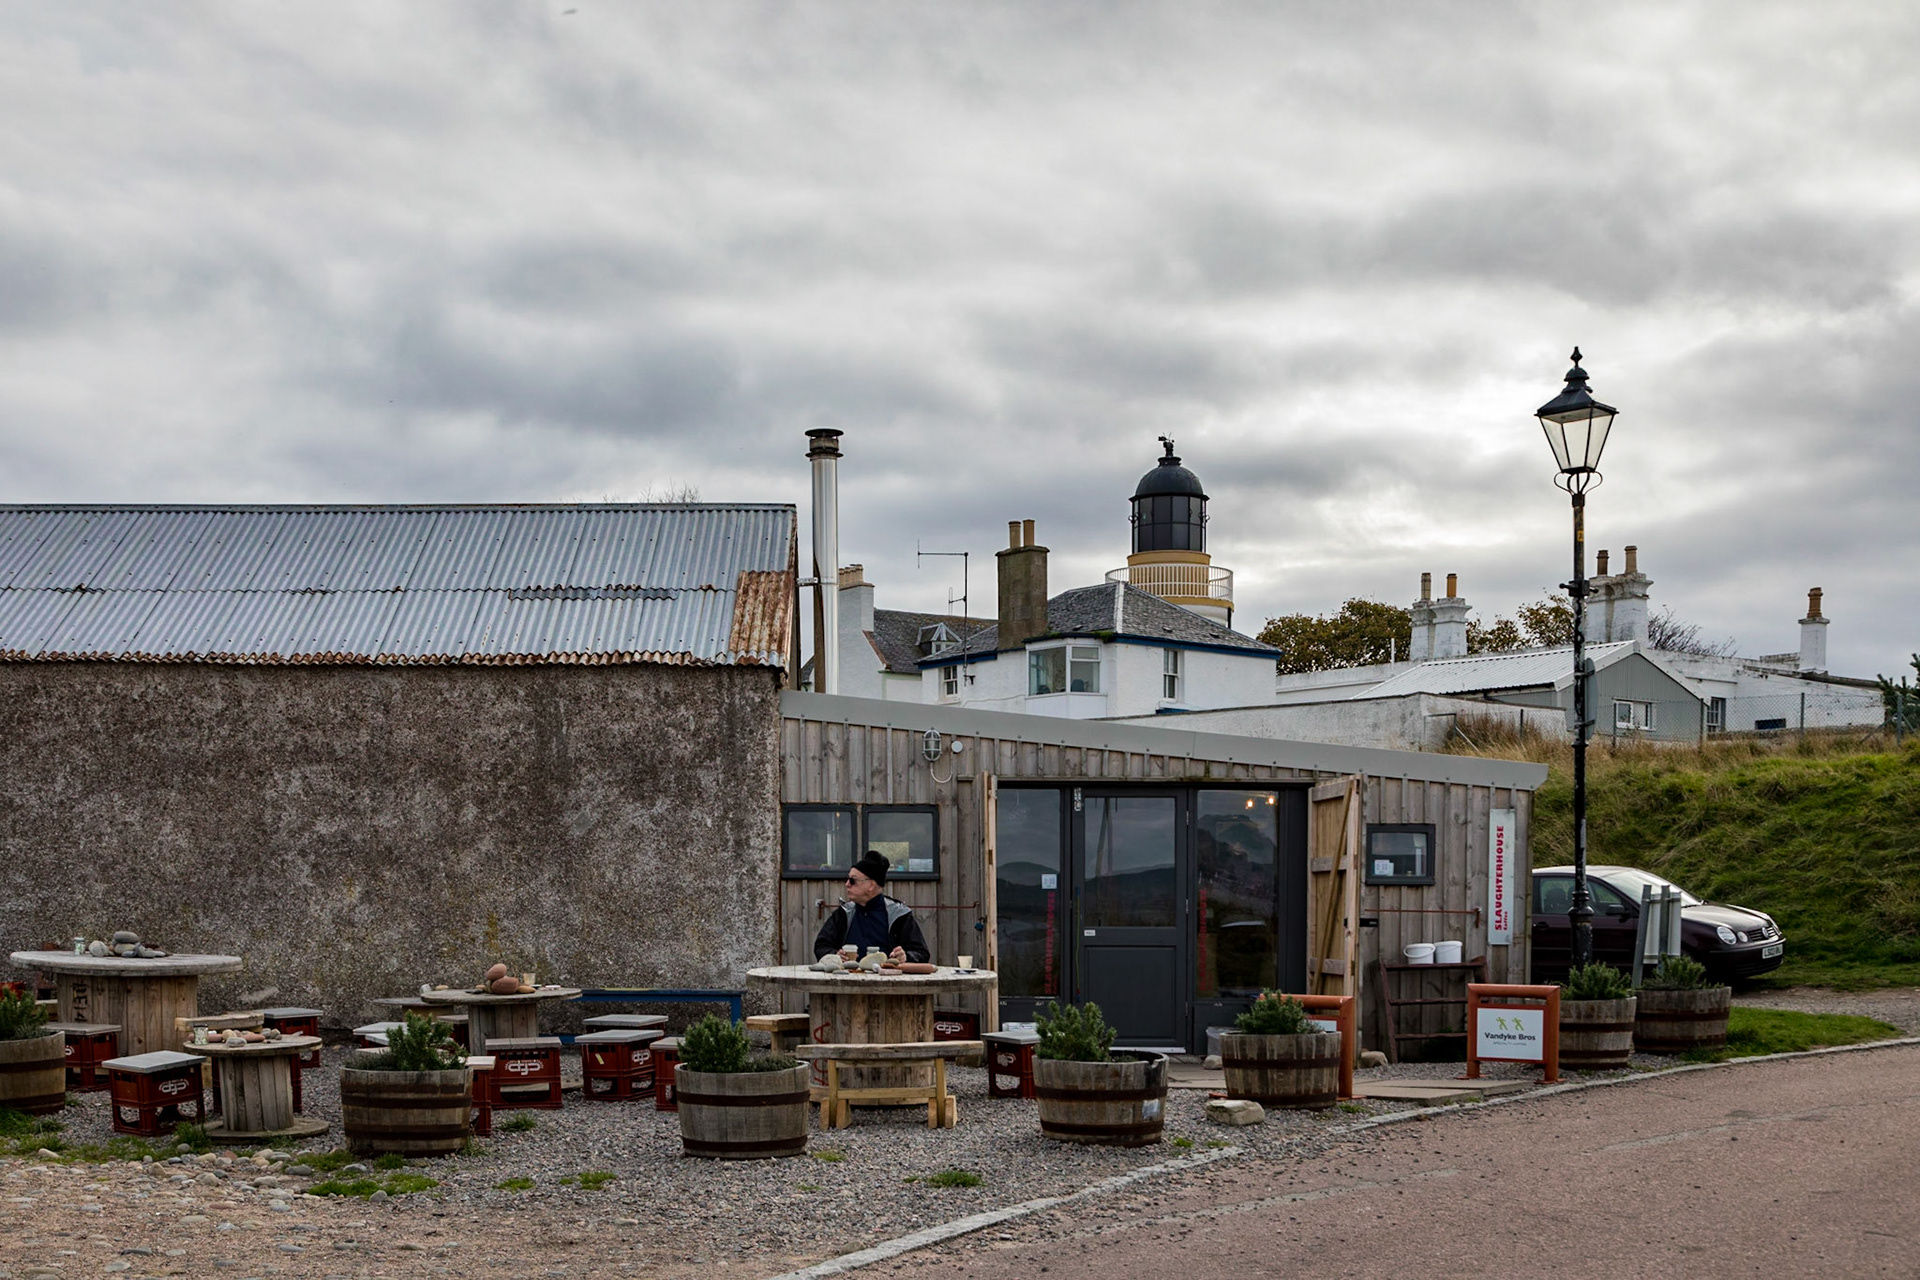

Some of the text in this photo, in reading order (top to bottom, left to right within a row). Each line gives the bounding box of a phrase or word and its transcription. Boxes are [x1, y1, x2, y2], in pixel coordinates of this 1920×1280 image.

[1495, 826, 1504, 931] SLAUGHTERHOUSE
[1484, 1032, 1536, 1041] Vandyke Bros
